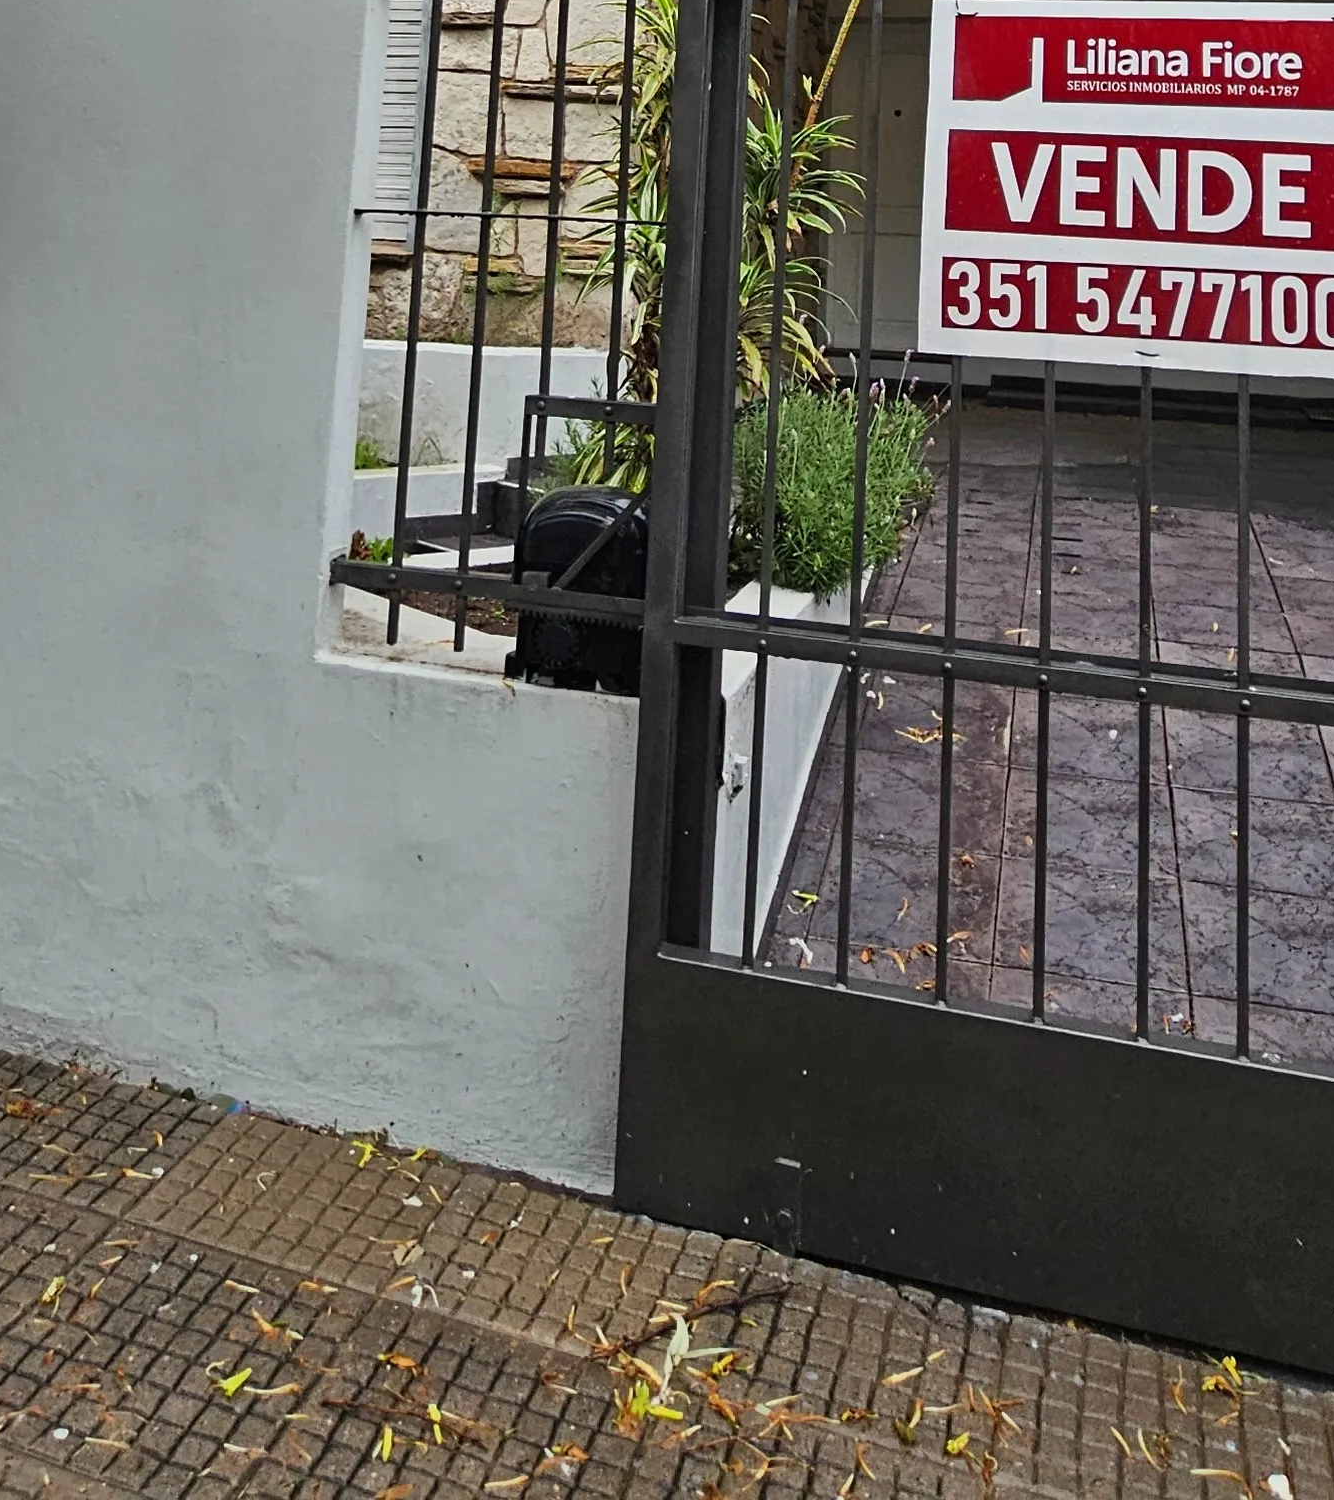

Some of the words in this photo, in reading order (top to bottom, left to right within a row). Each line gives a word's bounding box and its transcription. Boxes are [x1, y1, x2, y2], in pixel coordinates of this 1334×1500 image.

[1066, 39, 1188, 78] Liliana
[1203, 42, 1303, 80] Fiore
[1066, 80, 1127, 93] SERVICIOS
[1129, 82, 1222, 95] INMOBILIARIOS
[1227, 84, 1246, 96] MP
[1249, 84, 1300, 97] 04-1787
[991, 141, 1312, 238] VENDE
[947, 261, 1048, 330] 351
